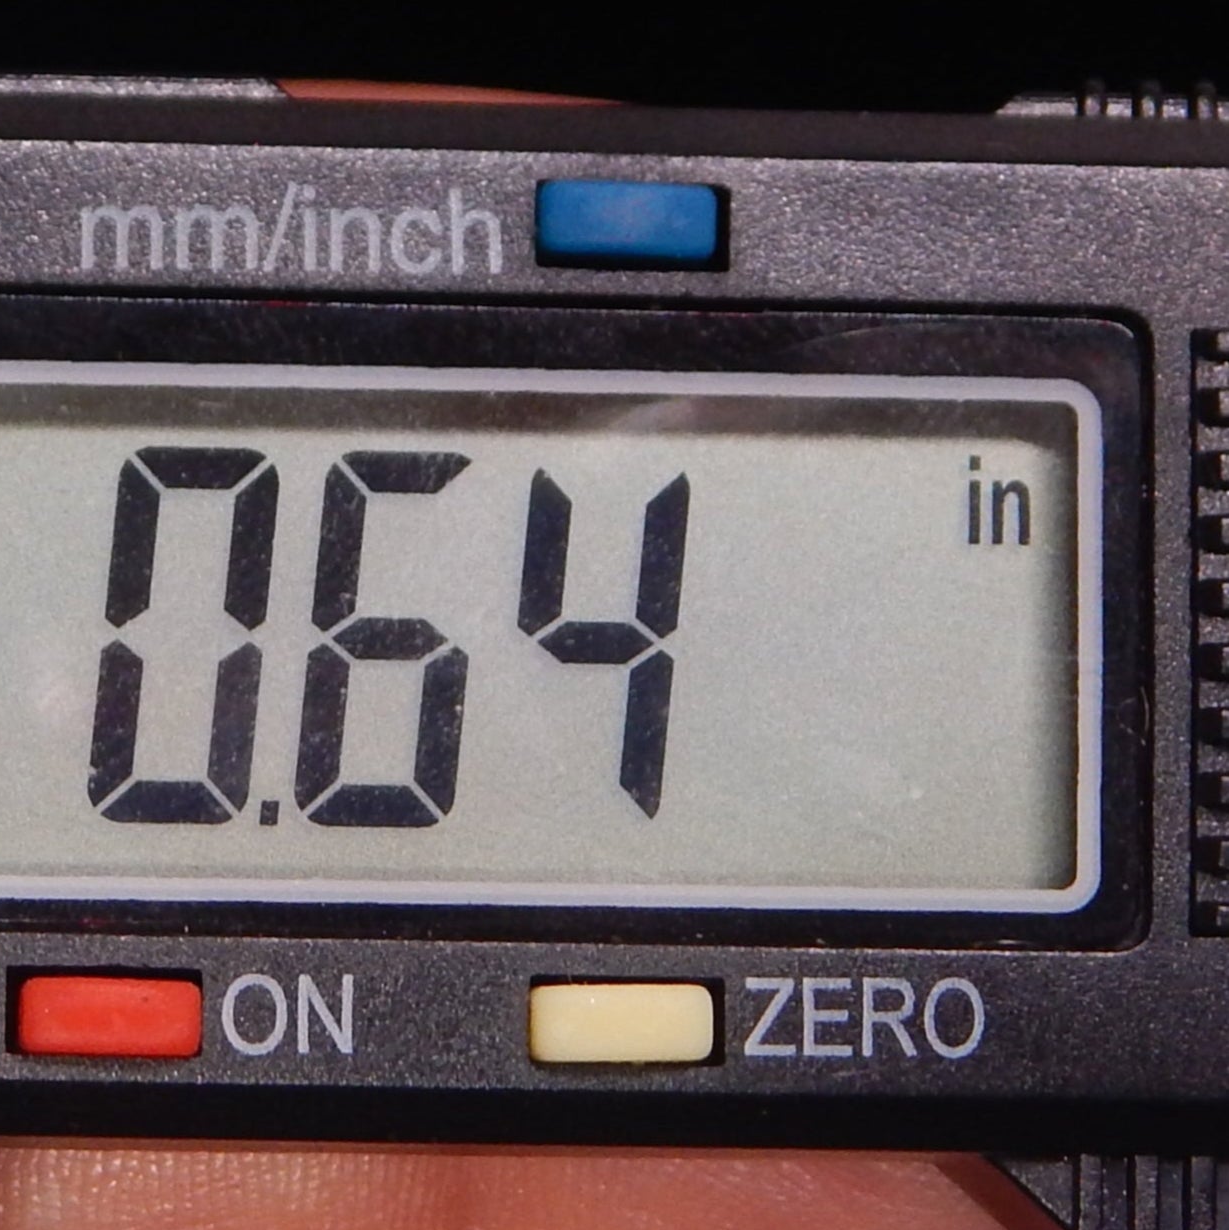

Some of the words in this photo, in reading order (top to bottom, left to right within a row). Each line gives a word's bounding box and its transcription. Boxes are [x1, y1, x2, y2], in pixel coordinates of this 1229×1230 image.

[76, 182, 504, 278] mm/inch
[966, 457, 1033, 547] in
[87, 445, 692, 829] 0.64
[221, 974, 357, 1056] ON
[743, 977, 986, 1060] ZERO
